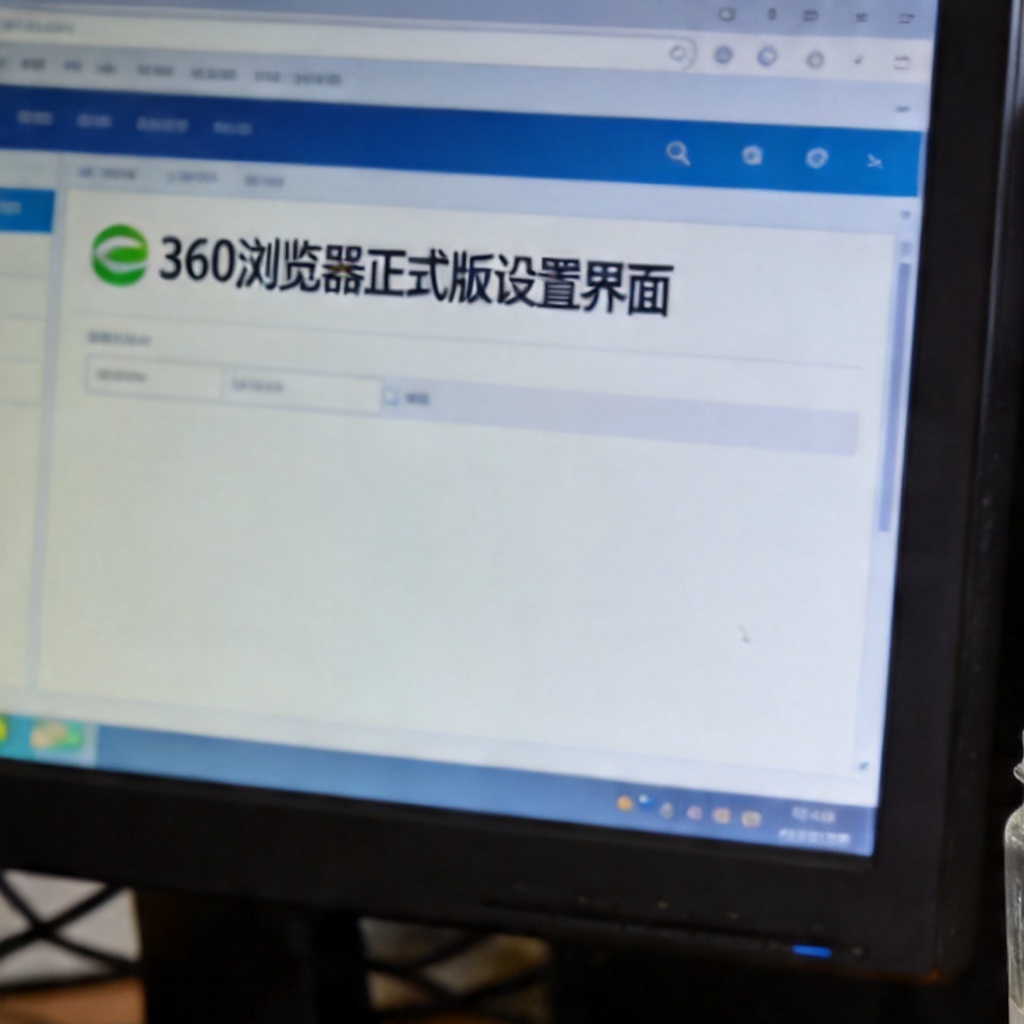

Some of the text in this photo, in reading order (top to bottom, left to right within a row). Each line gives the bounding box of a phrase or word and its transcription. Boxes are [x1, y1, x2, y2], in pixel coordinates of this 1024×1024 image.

[159, 236, 674, 317] 360浏览器正式版设置界面
